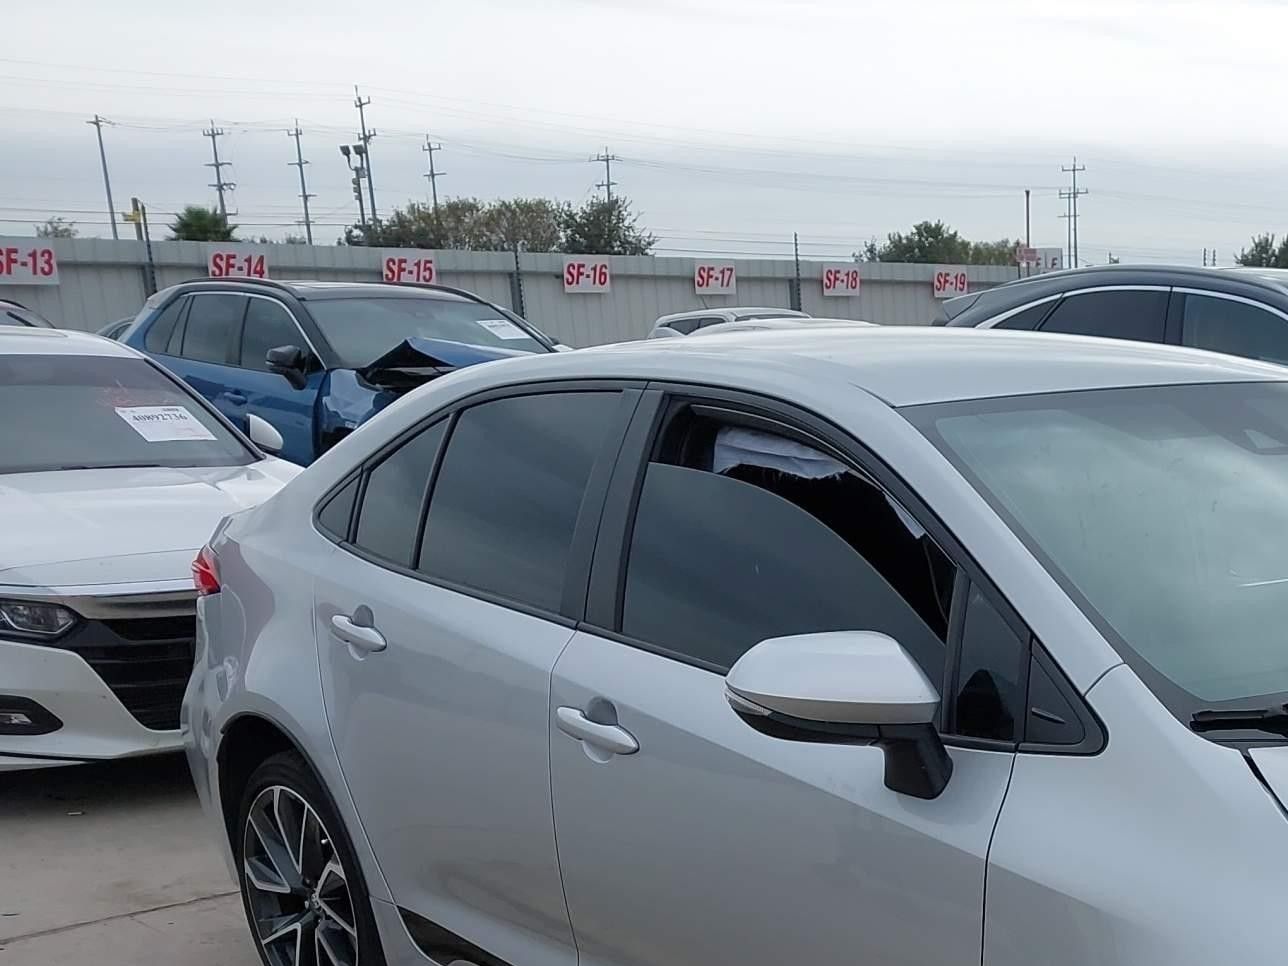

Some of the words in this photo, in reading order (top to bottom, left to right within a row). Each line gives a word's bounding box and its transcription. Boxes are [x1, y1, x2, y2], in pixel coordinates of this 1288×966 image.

[211, 253, 265, 278] SF-14
[385, 257, 433, 283] SF-15
[566, 262, 608, 286] SF-16
[696, 266, 734, 288] SF-17
[825, 269, 858, 290] SF-18
[935, 271, 966, 292] SF-19
